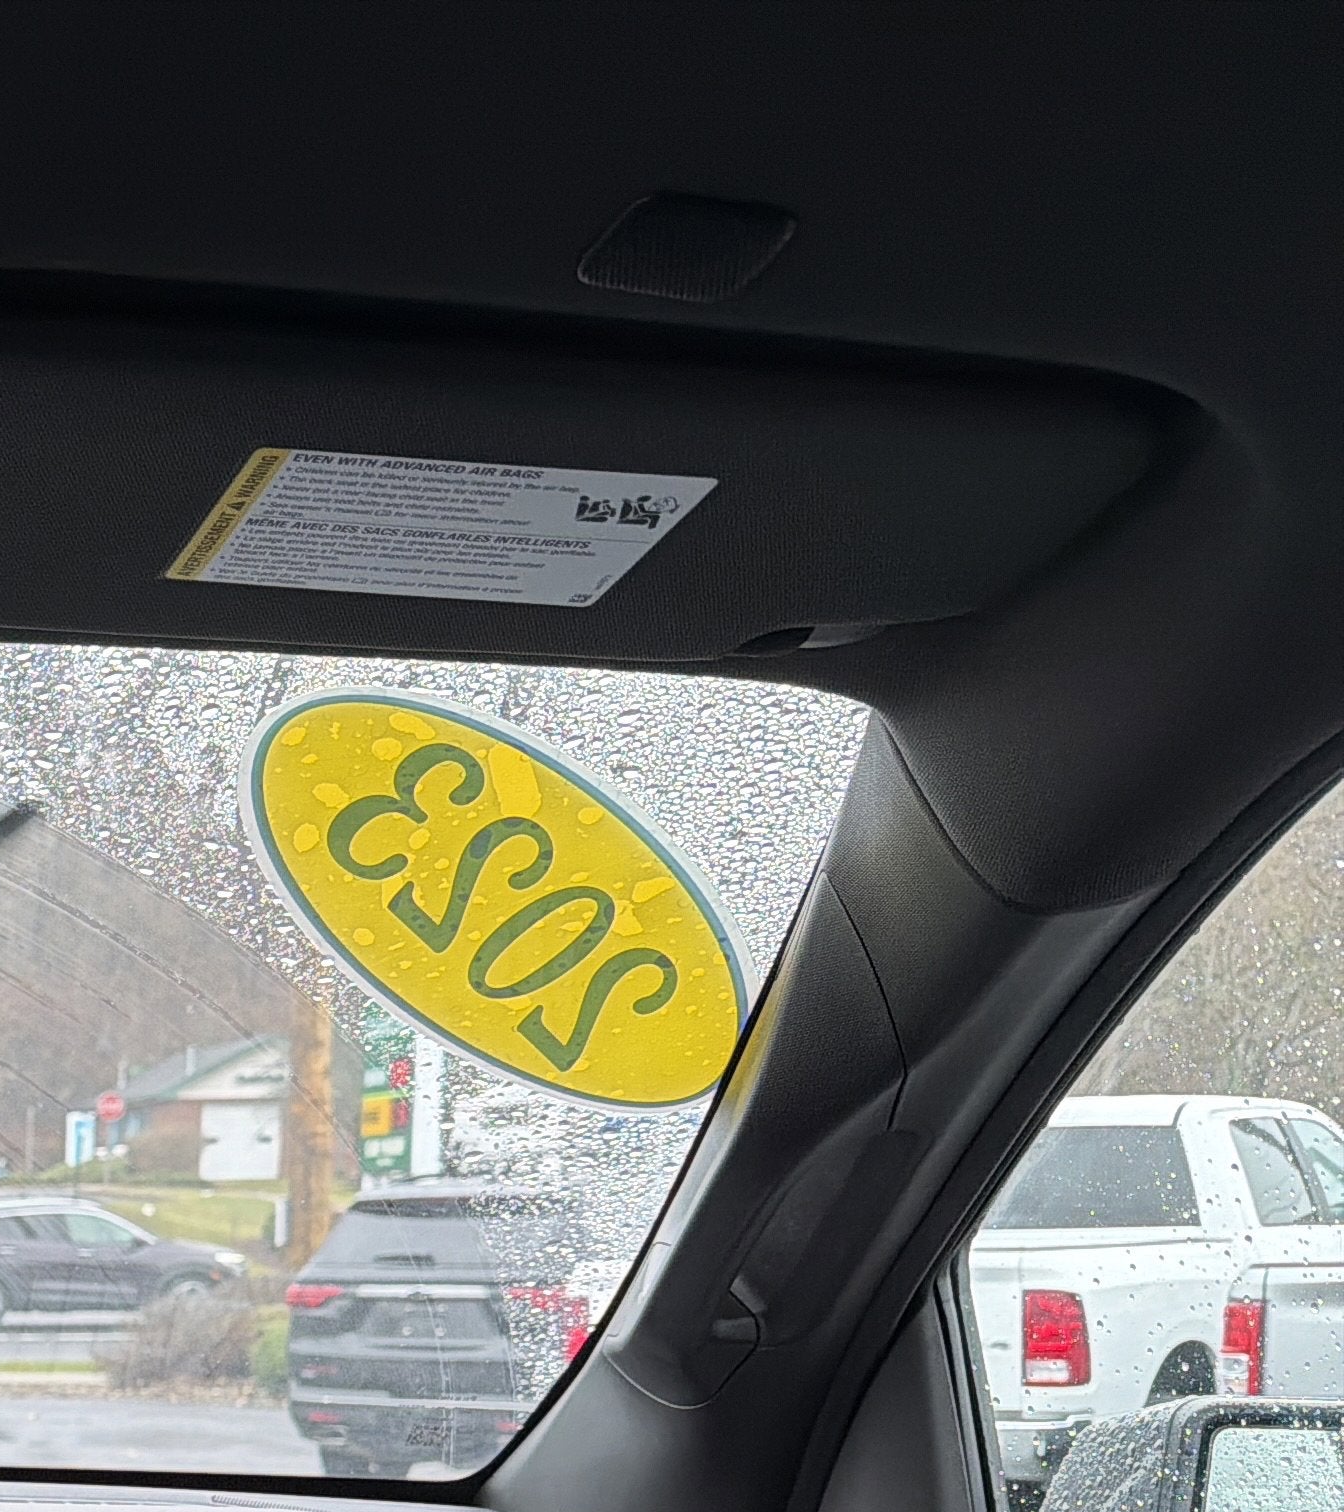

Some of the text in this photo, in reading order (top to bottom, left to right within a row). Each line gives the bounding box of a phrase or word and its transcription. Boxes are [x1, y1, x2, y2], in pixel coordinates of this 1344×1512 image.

[234, 454, 281, 500] WARNING
[291, 453, 546, 479] EVEN WITH ADVANCED AIR BAGS
[177, 511, 238, 577] AVERTISSEMENT
[243, 517, 594, 548] MÊME AVEC DES SACS GONFLABLES INTELLIGENTS
